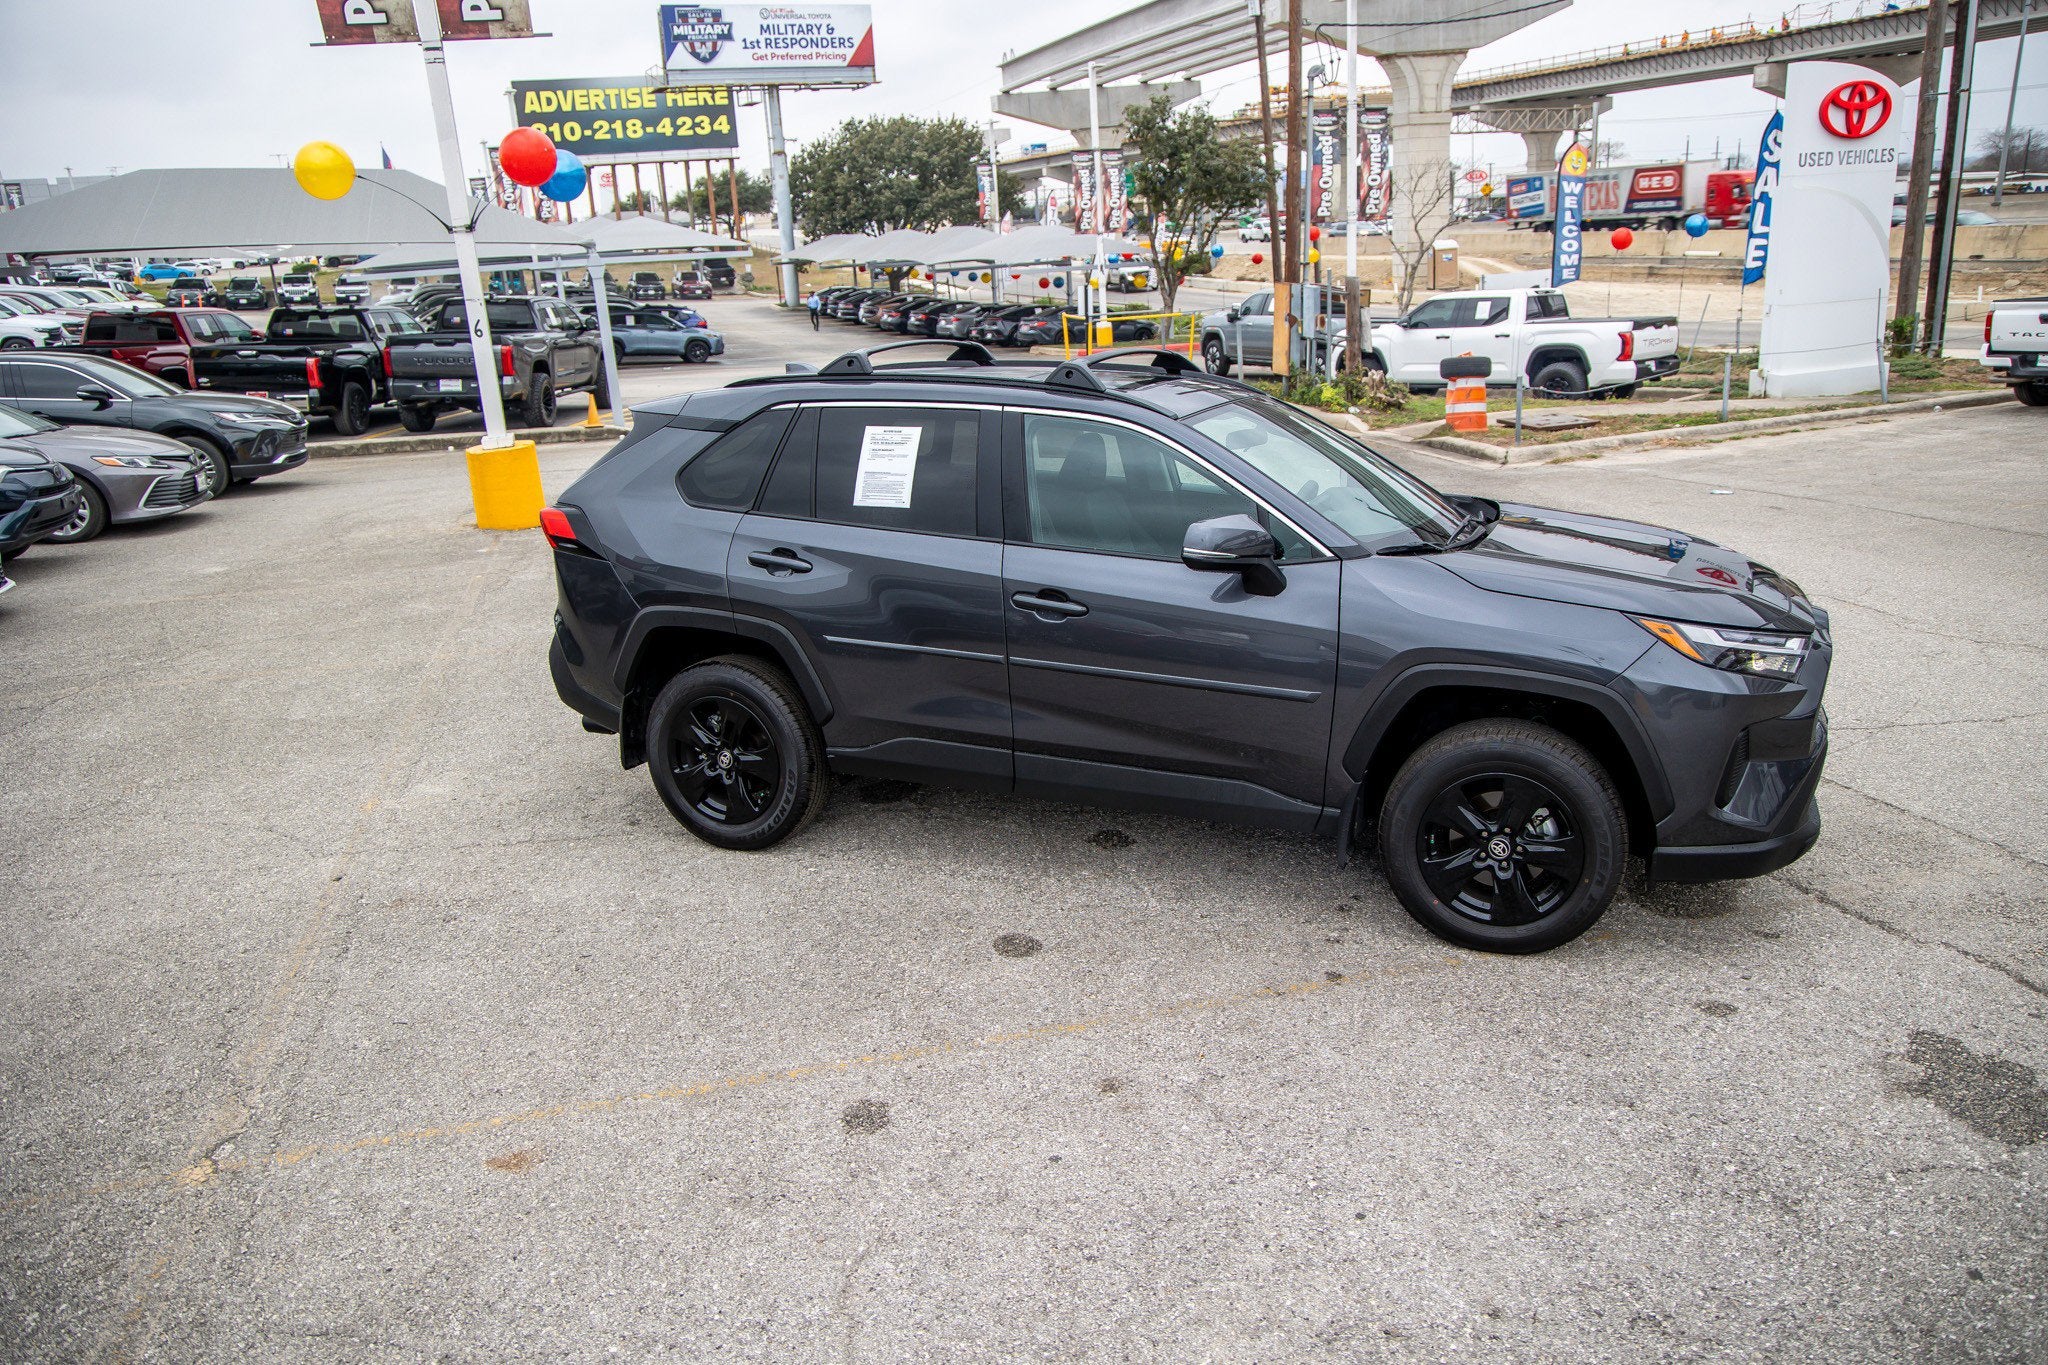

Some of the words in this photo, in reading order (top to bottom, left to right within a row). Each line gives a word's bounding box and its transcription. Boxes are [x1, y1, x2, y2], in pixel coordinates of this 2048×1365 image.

[672, 24, 730, 36] MILITARY
[759, 23, 823, 36] MILITARY
[826, 23, 835, 35] &
[741, 38, 761, 50] 1st
[765, 36, 855, 49] RESPONDERS
[751, 52, 768, 61] Get
[770, 52, 813, 61] Preferred
[815, 52, 847, 62] Pricing
[524, 86, 657, 114] ADVERTISE
[666, 87, 729, 107] HERE
[1318, 135, 1334, 189] Owned
[1367, 133, 1382, 187] Owned
[1798, 151, 1835, 168] USED
[1838, 147, 1896, 166] VEHICLES
[1078, 168, 1092, 209] Owned
[1107, 167, 1121, 208] Owned
[1746, 128, 1784, 269] SALE
[1316, 190, 1333, 217] Pre
[1365, 188, 1381, 214] Pre
[1080, 209, 1091, 231] Pre
[1109, 208, 1121, 229] Pre
[1559, 180, 1583, 280] WELCOME
[474, 318, 484, 338] 6
